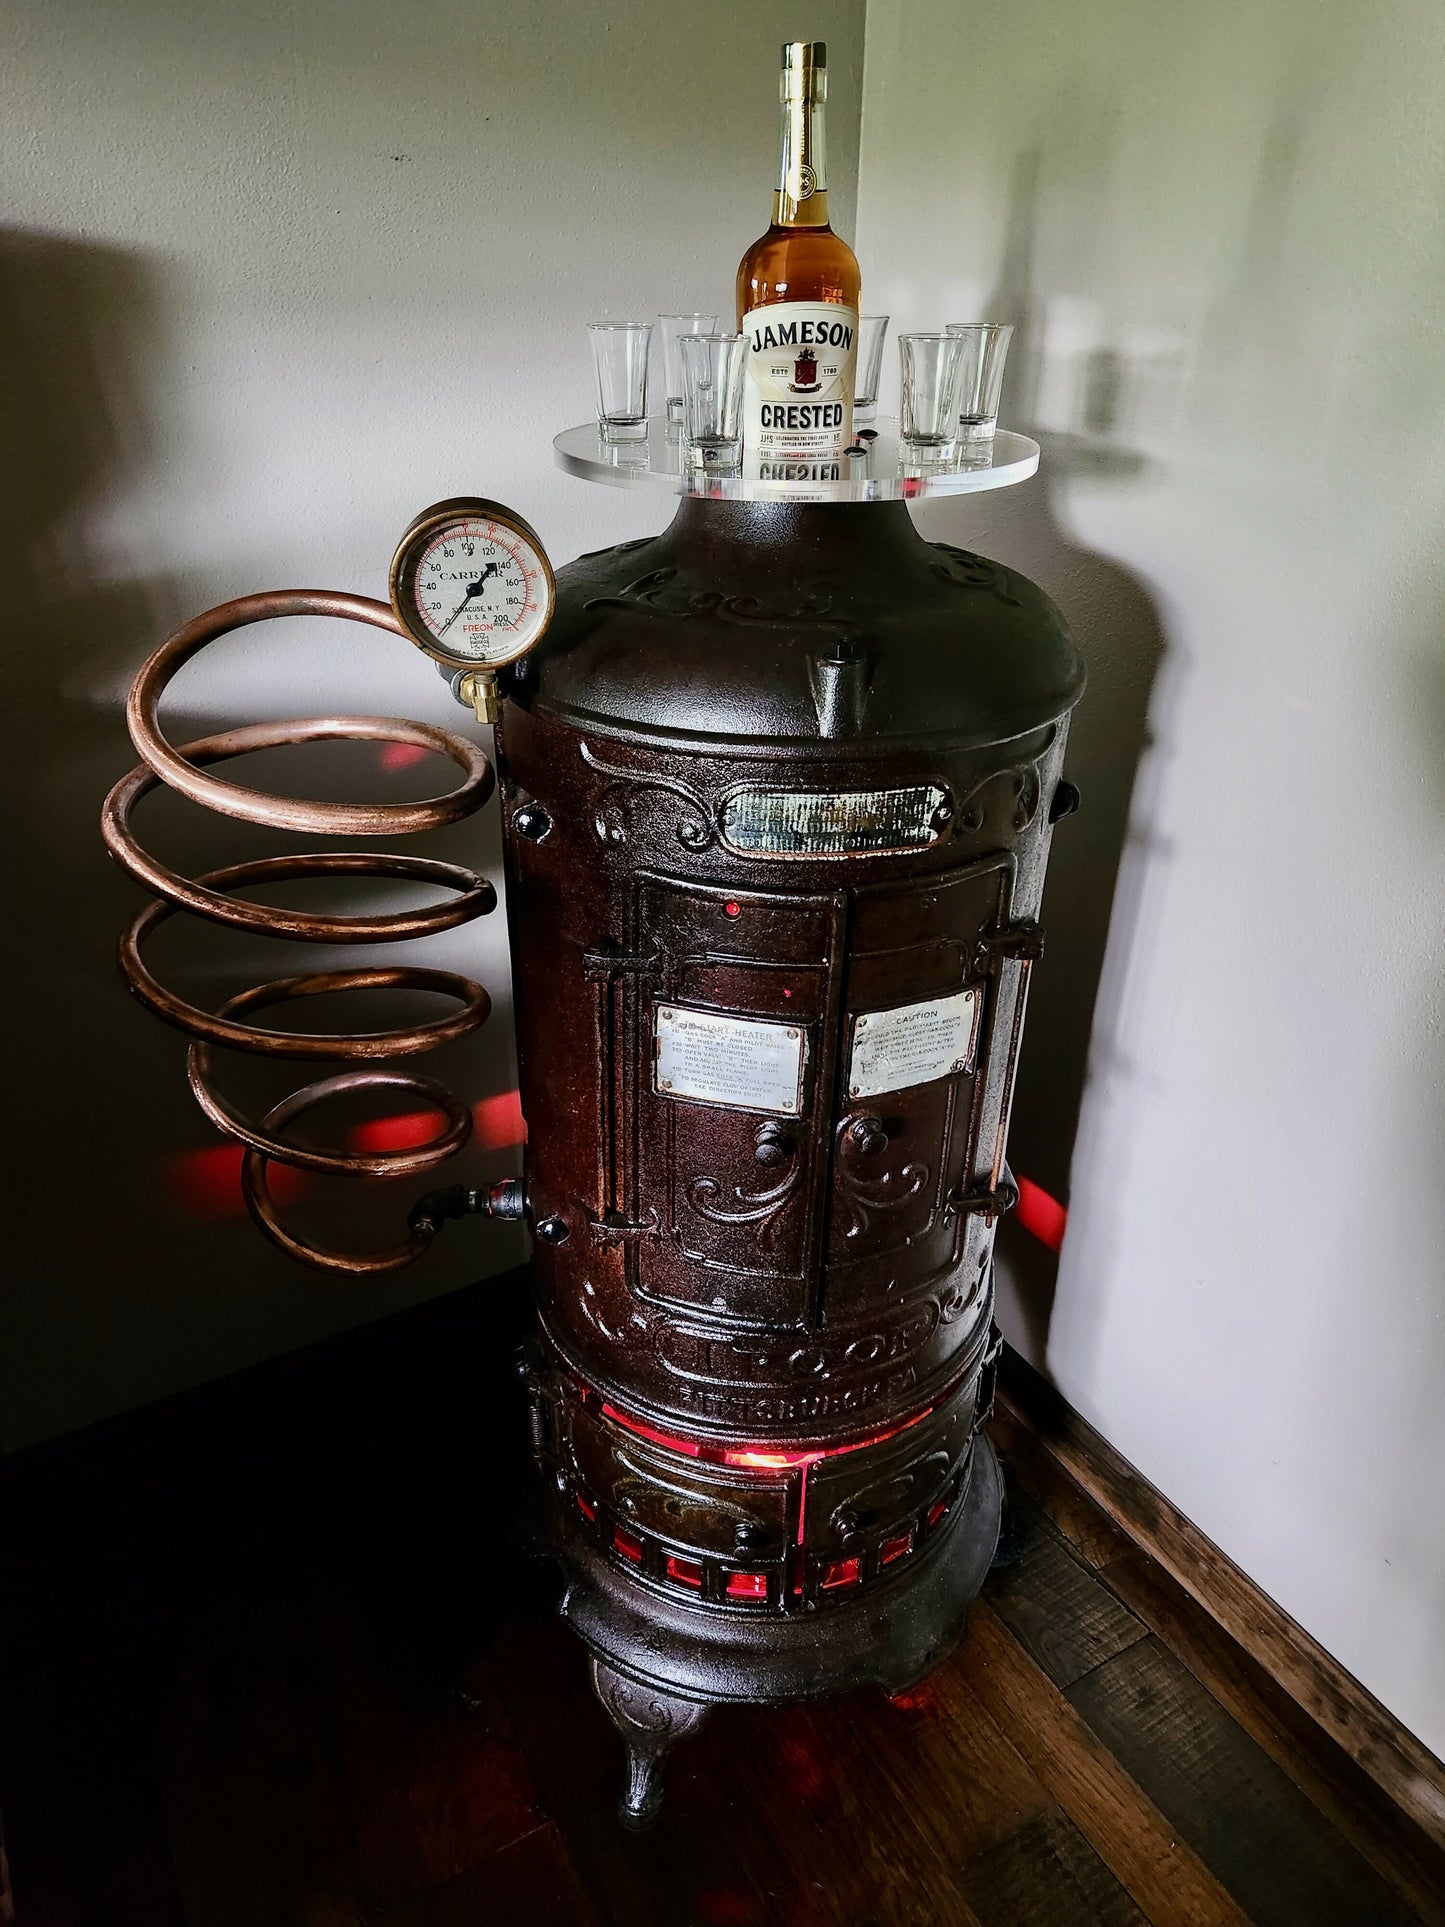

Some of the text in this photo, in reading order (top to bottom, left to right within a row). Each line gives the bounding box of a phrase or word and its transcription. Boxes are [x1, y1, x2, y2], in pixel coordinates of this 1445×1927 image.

[752, 321, 853, 352] JAMESON
[761, 404, 843, 429] CRESTED
[461, 542, 474, 550] 100
[444, 550, 454, 558] 80
[482, 547, 495, 556] 120
[430, 564, 441, 572] 60
[506, 597, 519, 605] 180
[432, 602, 442, 610] 20
[463, 624, 493, 632] FREON
[896, 1010, 938, 1024] CAUTION
[735, 1029, 772, 1041] HEATER
